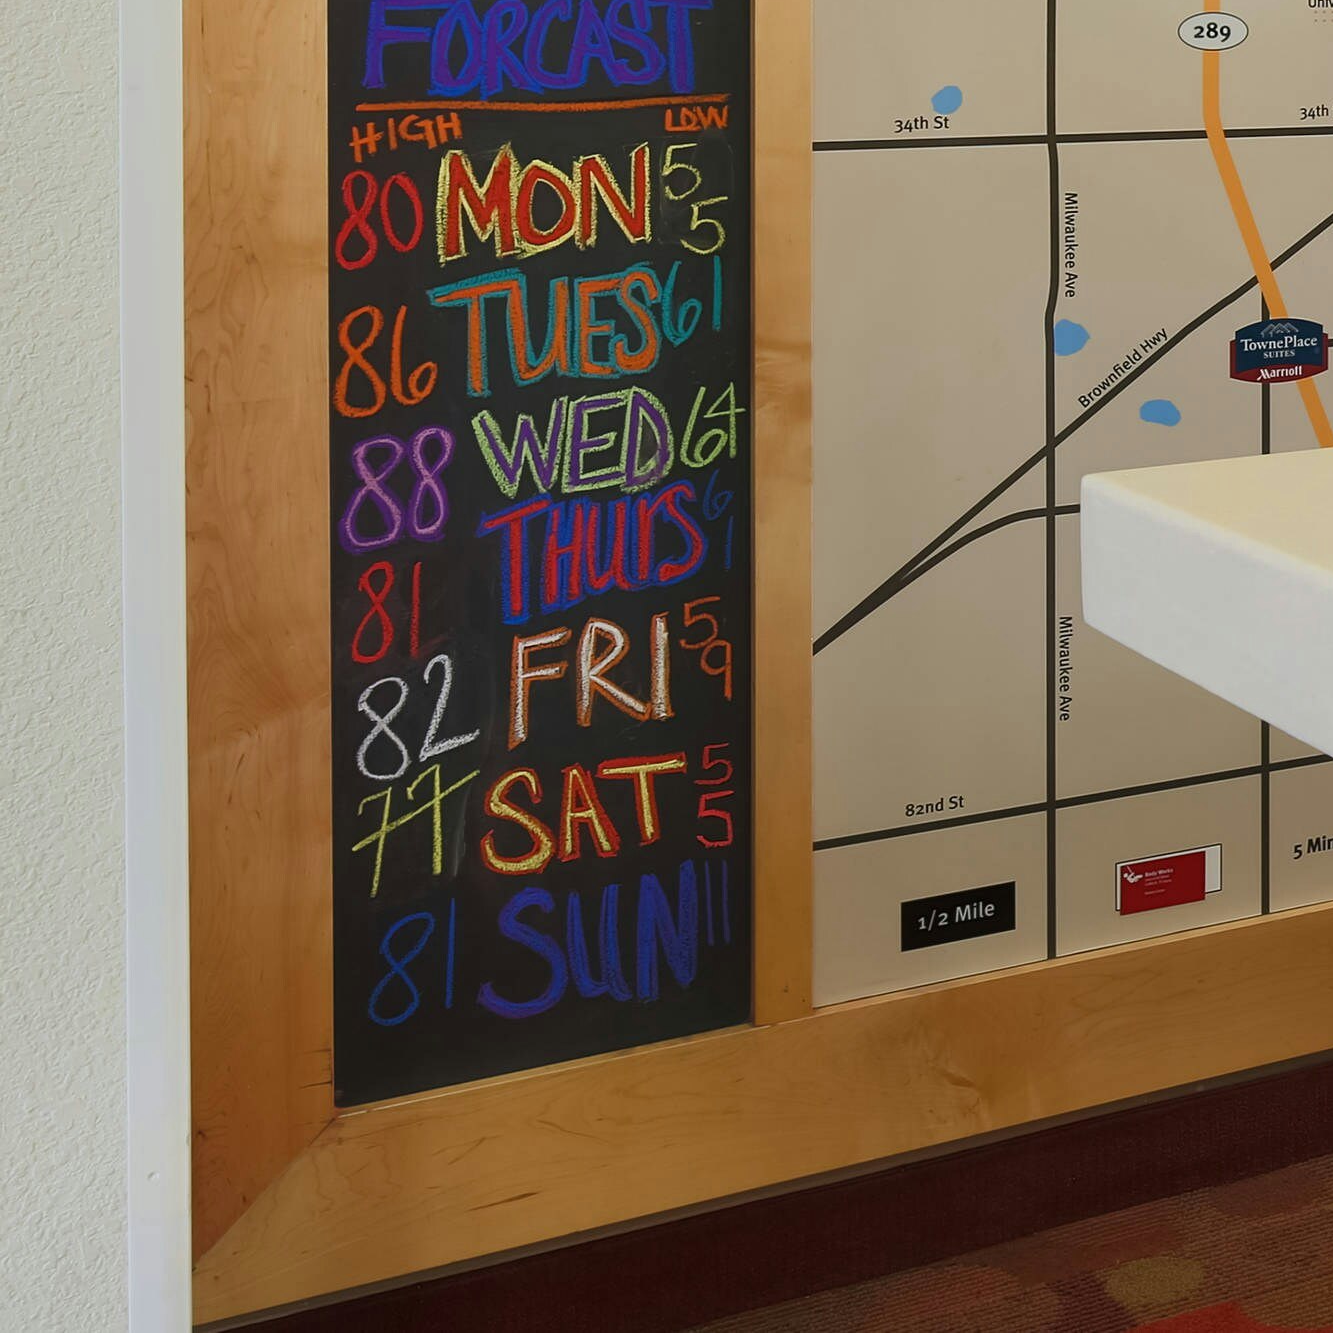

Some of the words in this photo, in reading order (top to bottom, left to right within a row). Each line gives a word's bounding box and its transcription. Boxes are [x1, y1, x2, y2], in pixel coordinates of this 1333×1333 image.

[1194, 23, 1231, 42] 289
[349, 111, 464, 164] HIGH
[664, 105, 729, 133] LOW
[895, 116, 928, 133] 34th
[934, 116, 949, 129] St
[335, 169, 424, 271] 80
[436, 142, 652, 267] MON
[334, 304, 438, 418] 86
[427, 262, 665, 400] TUES
[661, 254, 724, 348] 61
[1240, 335, 1318, 351] TownePlace
[1263, 349, 1295, 359] SUITES
[1077, 348, 1142, 410] Brownfield
[1139, 327, 1169, 362] Hwy
[1257, 365, 1302, 381] Marriott
[339, 424, 455, 556] 88
[471, 385, 676, 499] WED
[679, 386, 746, 469] 64
[350, 560, 424, 665] 81
[1060, 617, 1073, 687] Milwaukee
[355, 653, 481, 782] 82
[507, 610, 676, 752] FRI
[1060, 690, 1072, 720] Ave
[350, 764, 481, 898] 77
[479, 751, 689, 877] SAT
[906, 798, 943, 816] 82nd
[949, 796, 964, 809] St
[1294, 845, 1302, 859] 5
[367, 897, 456, 1027] 81
[476, 857, 697, 1023] SUN
[919, 910, 948, 930] 1/2
[956, 902, 994, 922] Mile
